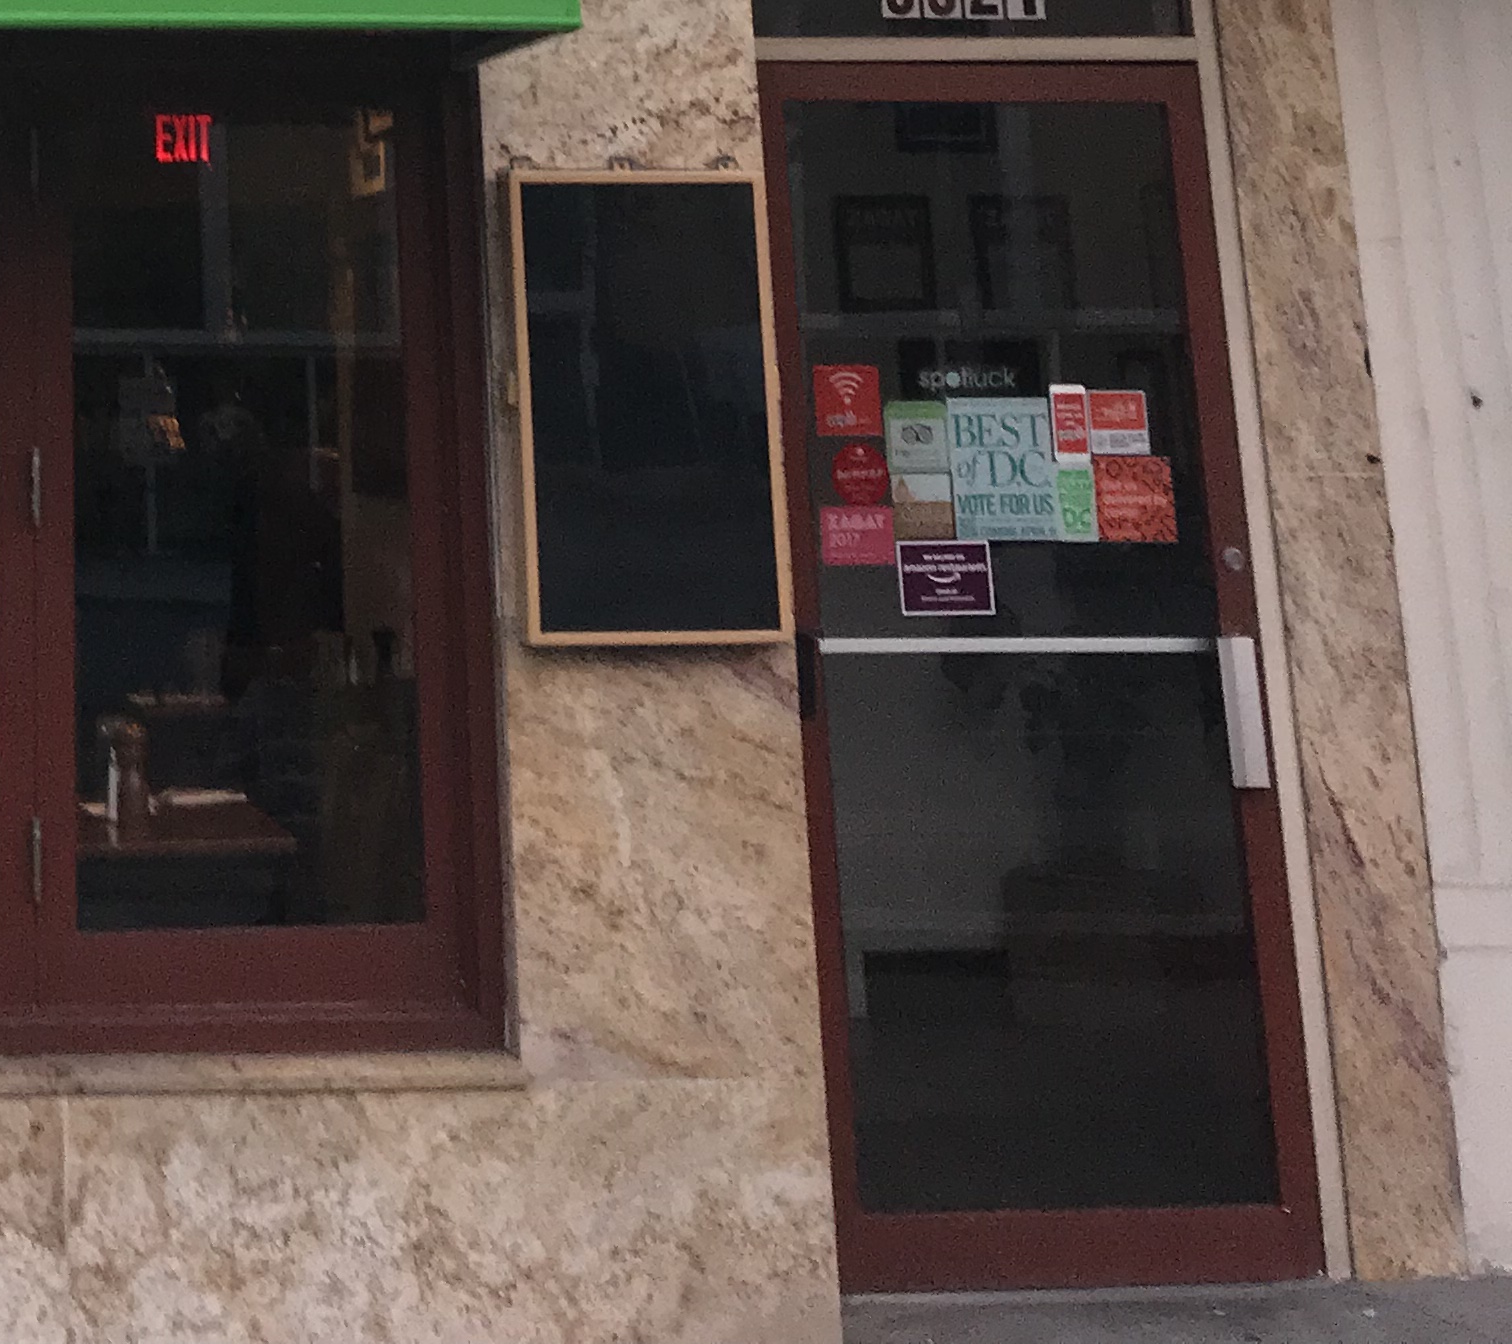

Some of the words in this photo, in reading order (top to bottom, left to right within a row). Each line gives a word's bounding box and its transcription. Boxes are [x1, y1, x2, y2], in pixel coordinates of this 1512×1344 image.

[155, 114, 213, 163] EXIT
[950, 412, 1049, 449] BEST
[956, 450, 984, 488] of
[956, 493, 997, 516] VOTE
[999, 493, 1031, 515] FOR
[1032, 493, 1056, 516] US
